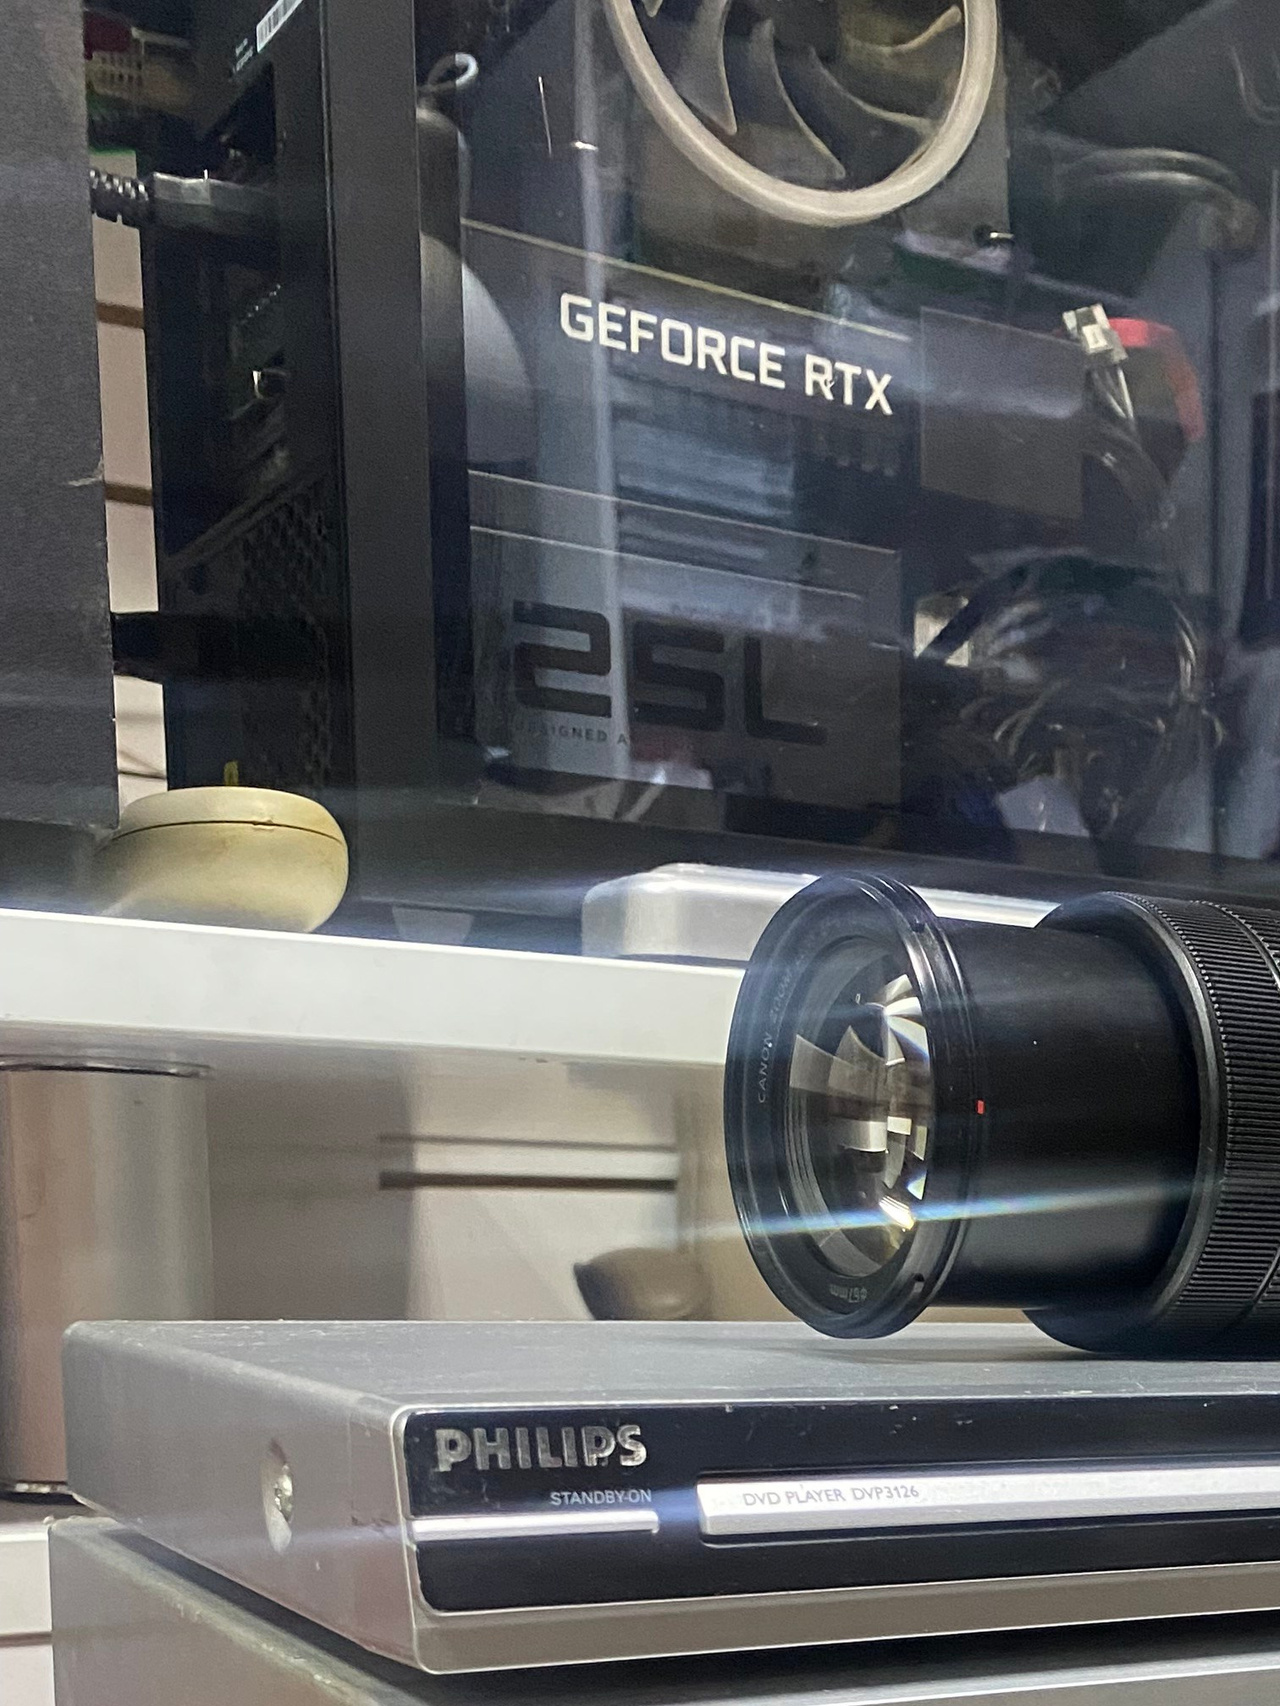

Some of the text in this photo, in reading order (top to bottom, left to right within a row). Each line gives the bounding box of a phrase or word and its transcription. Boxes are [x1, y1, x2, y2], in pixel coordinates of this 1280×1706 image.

[560, 292, 893, 416] GEFORCE RTX
[758, 1031, 773, 1104] CANON
[434, 1424, 648, 1472] PHILIPS
[550, 1487, 653, 1507] STANDBY-ON
[742, 1484, 920, 1507] DVD PLAYER DVP3126
